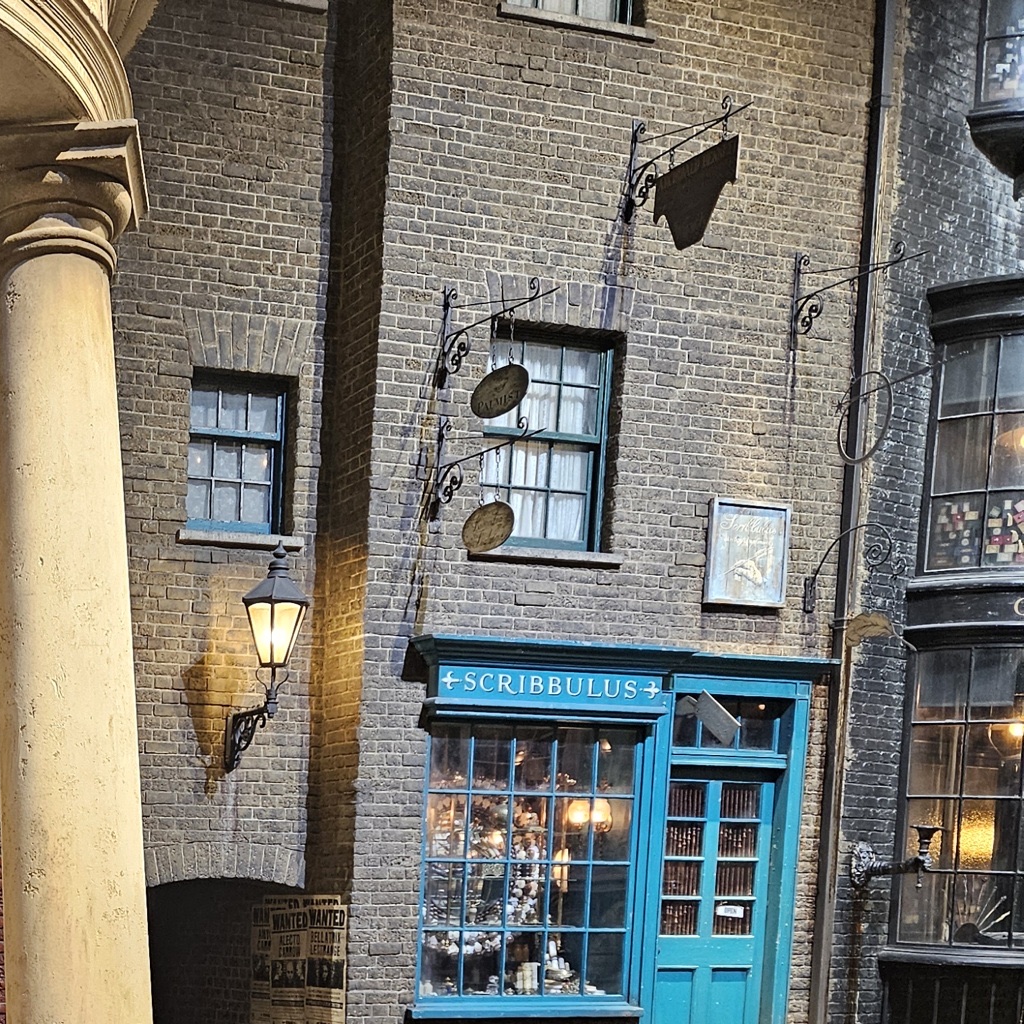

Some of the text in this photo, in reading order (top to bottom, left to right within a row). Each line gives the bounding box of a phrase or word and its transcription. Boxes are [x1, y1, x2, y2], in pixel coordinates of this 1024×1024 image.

[463, 671, 638, 699] SCRIBBULUS
[253, 907, 270, 923] WAN
[272, 911, 308, 930] WANTED
[309, 909, 345, 927] WANTED
